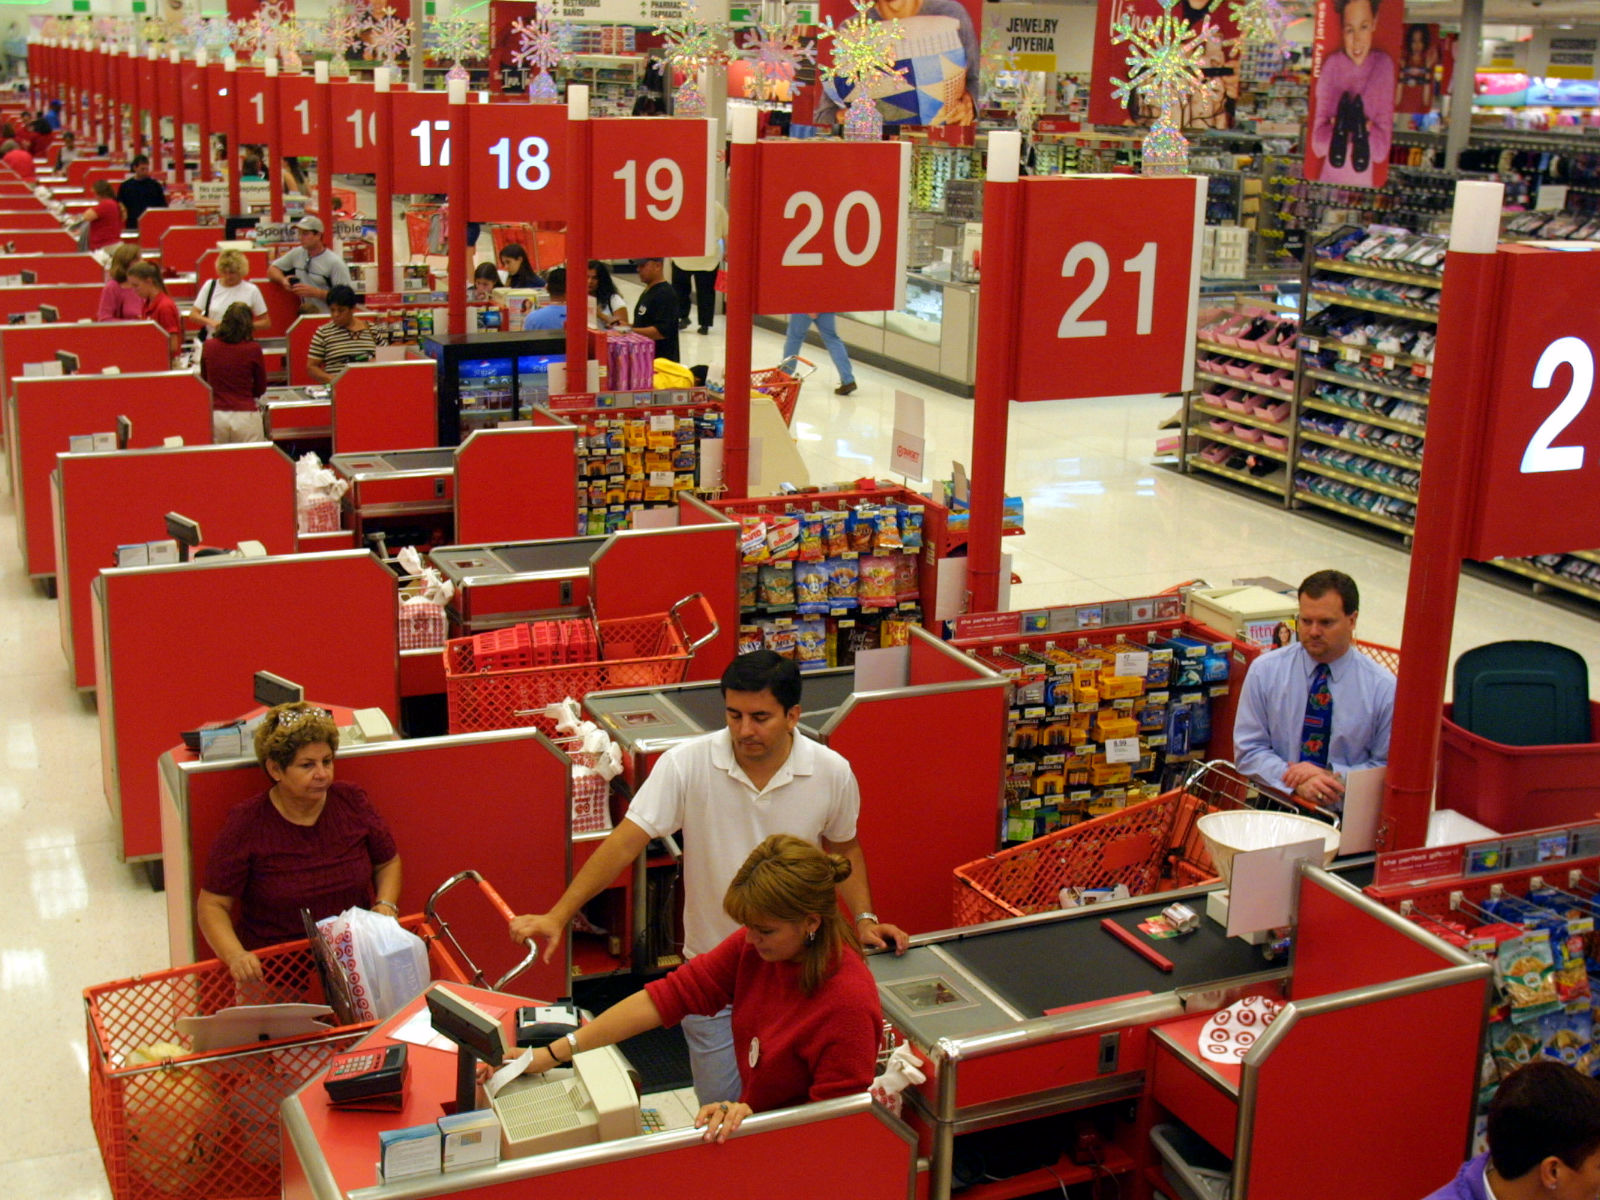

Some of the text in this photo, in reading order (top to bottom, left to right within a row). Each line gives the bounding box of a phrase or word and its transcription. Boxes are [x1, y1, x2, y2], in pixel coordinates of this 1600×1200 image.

[1006, 18, 1058, 33] JEWELRY
[1008, 37, 1054, 52] JOYERIA
[1313, 2, 1327, 77] mary janes
[249, 92, 264, 124] 1
[294, 99, 309, 135] 1
[410, 120, 450, 167] 17
[488, 136, 551, 190] 18
[613, 157, 684, 221] 19
[781, 189, 882, 268] 20
[1057, 241, 1157, 338] 21
[1250, 626, 1272, 639] fitn
